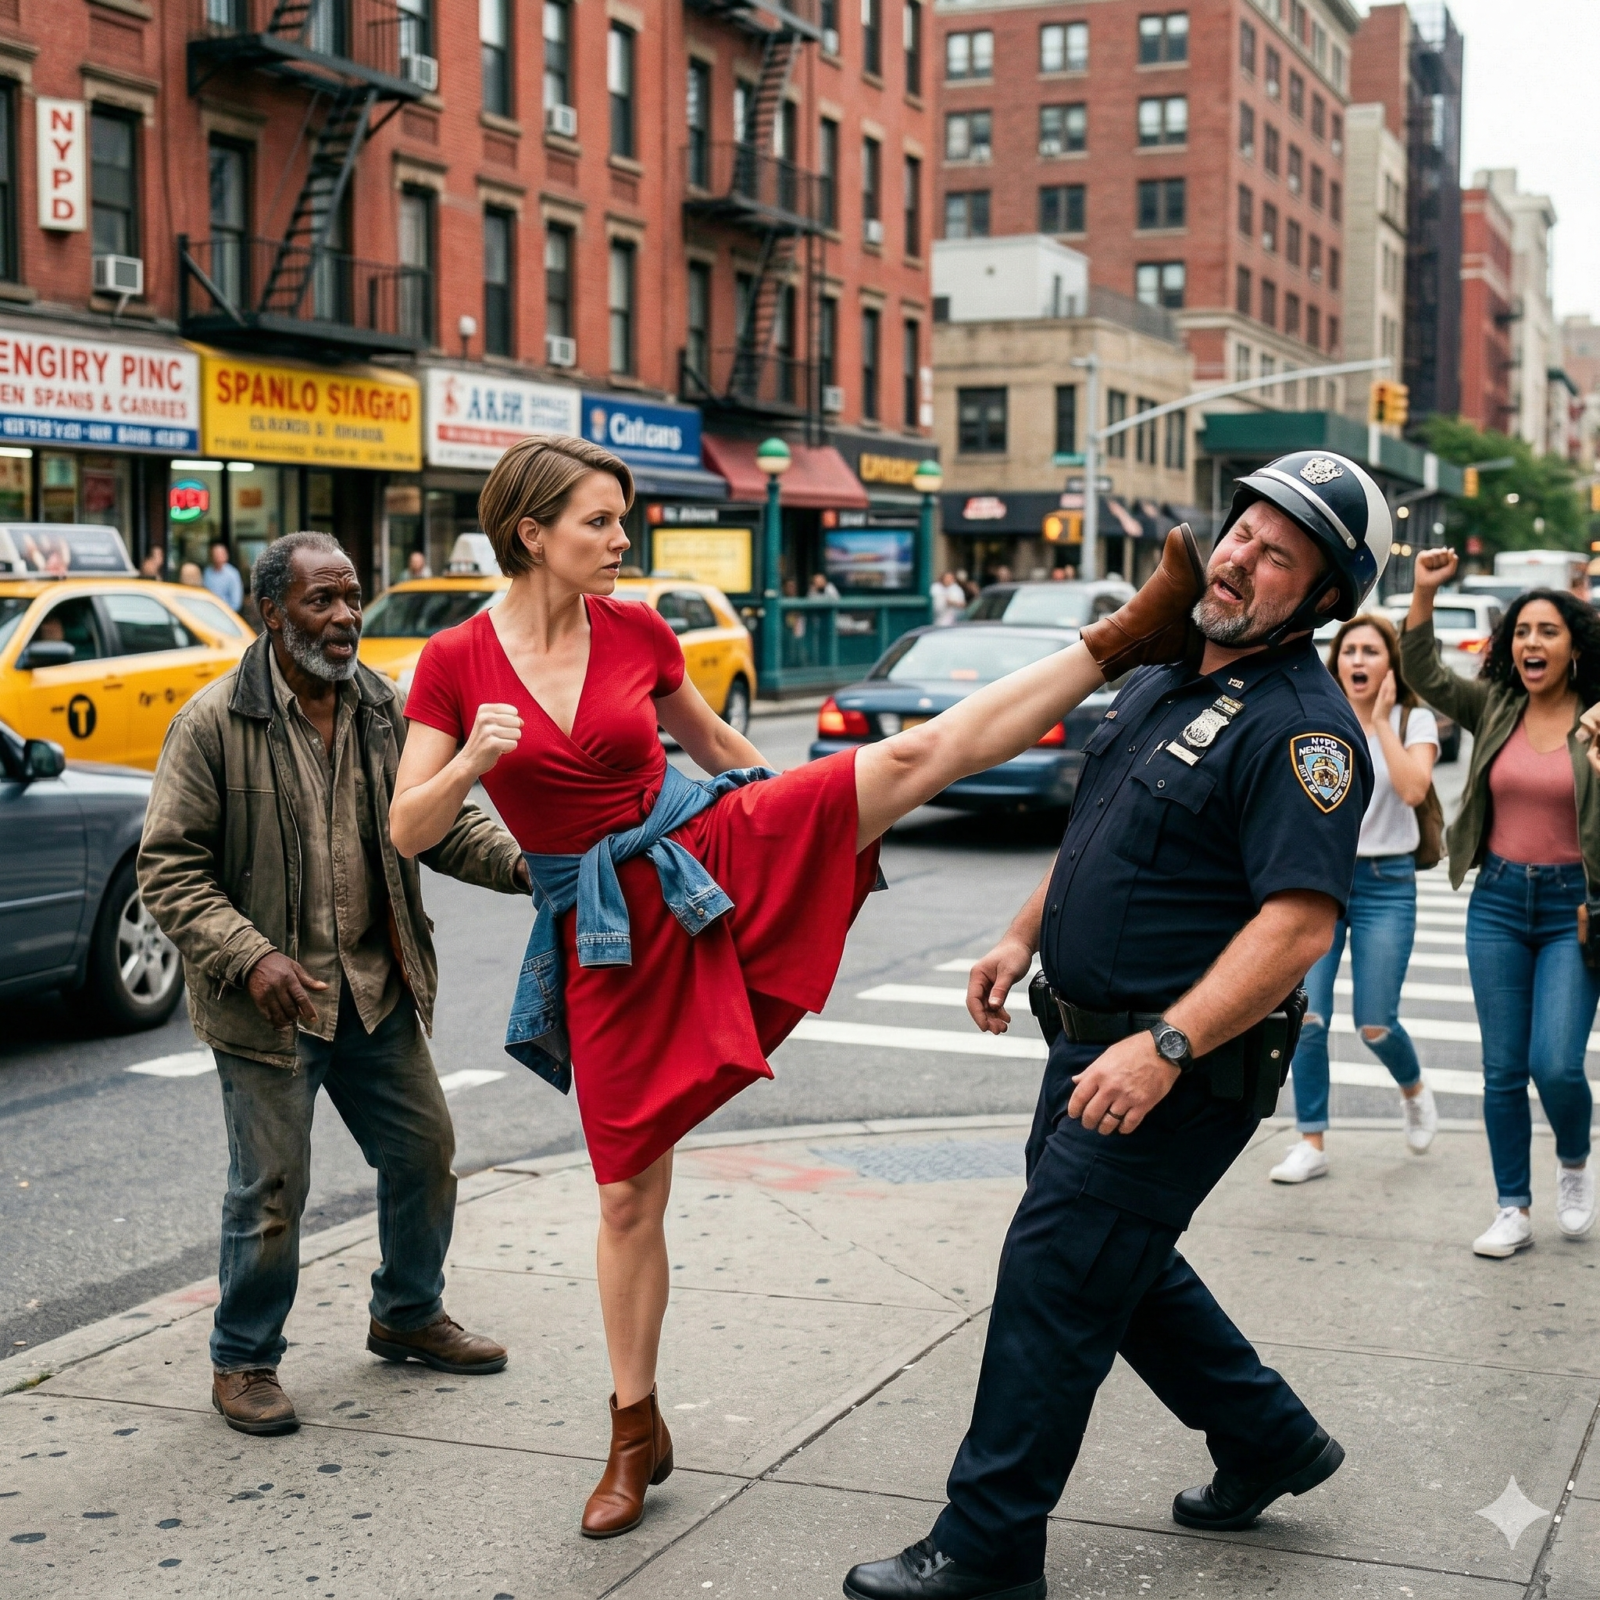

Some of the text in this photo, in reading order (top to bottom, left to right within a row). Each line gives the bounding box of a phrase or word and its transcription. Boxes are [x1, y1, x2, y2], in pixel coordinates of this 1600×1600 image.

[51, 109, 74, 219] NYPD
[122, 354, 183, 392] PINC
[72, 702, 90, 736] T
